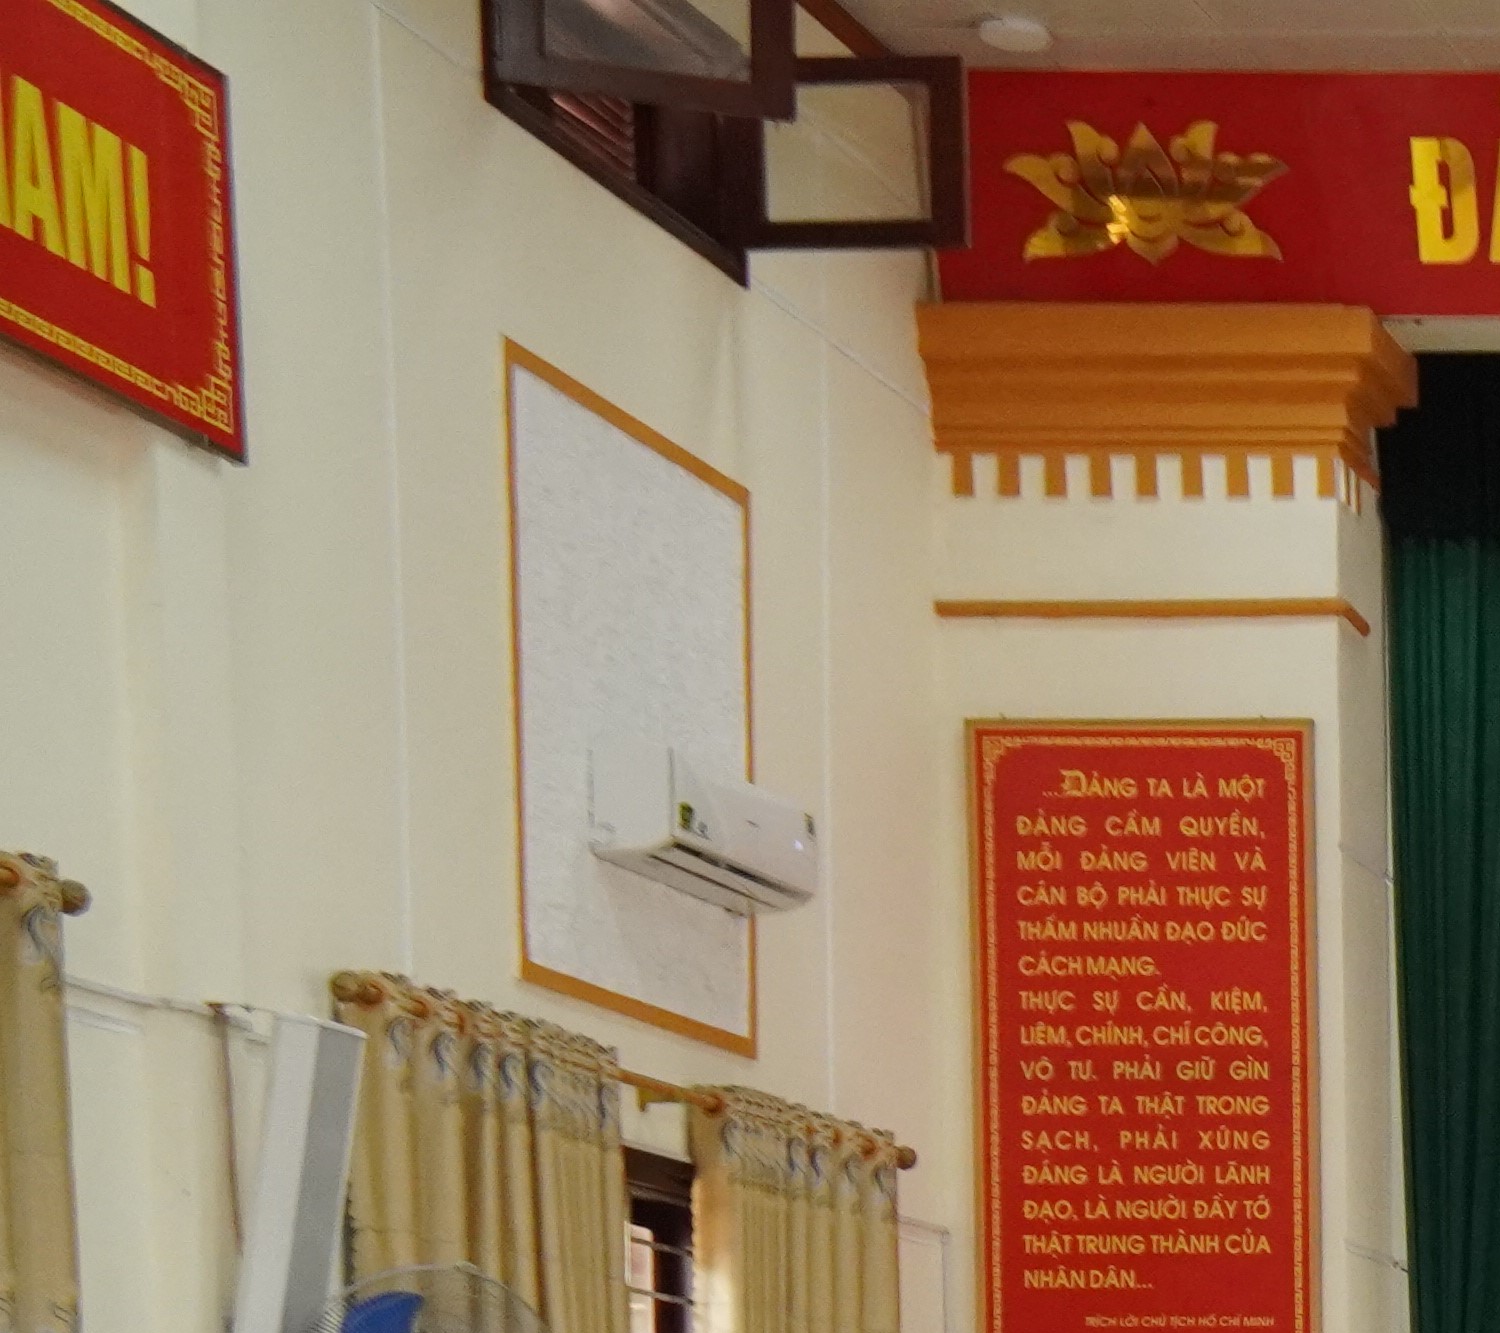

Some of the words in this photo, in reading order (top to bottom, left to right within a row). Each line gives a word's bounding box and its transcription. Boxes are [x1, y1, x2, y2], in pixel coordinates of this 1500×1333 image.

[0, 74, 157, 309] AM!
[1146, 778, 1174, 797] TA
[1182, 773, 1209, 798] LÀ
[1217, 774, 1266, 802] MỘT
[1015, 809, 1088, 838] ĐẢNG
[1104, 809, 1162, 836] CẦM
[1017, 951, 1084, 976] CÁCH
[1018, 990, 1075, 1013] THỰC
[1092, 991, 1120, 1014] SỰ
[1152, 1021, 1191, 1045] CHÍ
[1020, 1089, 1088, 1115] ĐẢNG
[1097, 1095, 1125, 1114] TA
[1135, 1092, 1186, 1118] THẬT
[1195, 1095, 1271, 1115] TRONG
[1119, 1124, 1178, 1149] PHẢI
[1198, 1125, 1271, 1150] XỨNG
[1021, 1160, 1089, 1184] ĐÁNG
[1097, 1160, 1124, 1184] LÀ
[1133, 1160, 1205, 1185] NGƯỜI
[1214, 1161, 1271, 1184] LÃNH
[1022, 1231, 1073, 1257] THẬT
[1075, 1235, 1146, 1254] TRUNG
[1149, 1229, 1221, 1253] THÀNH
[1223, 1228, 1272, 1254] CỦA
[1023, 1265, 1087, 1288] NHÂN
